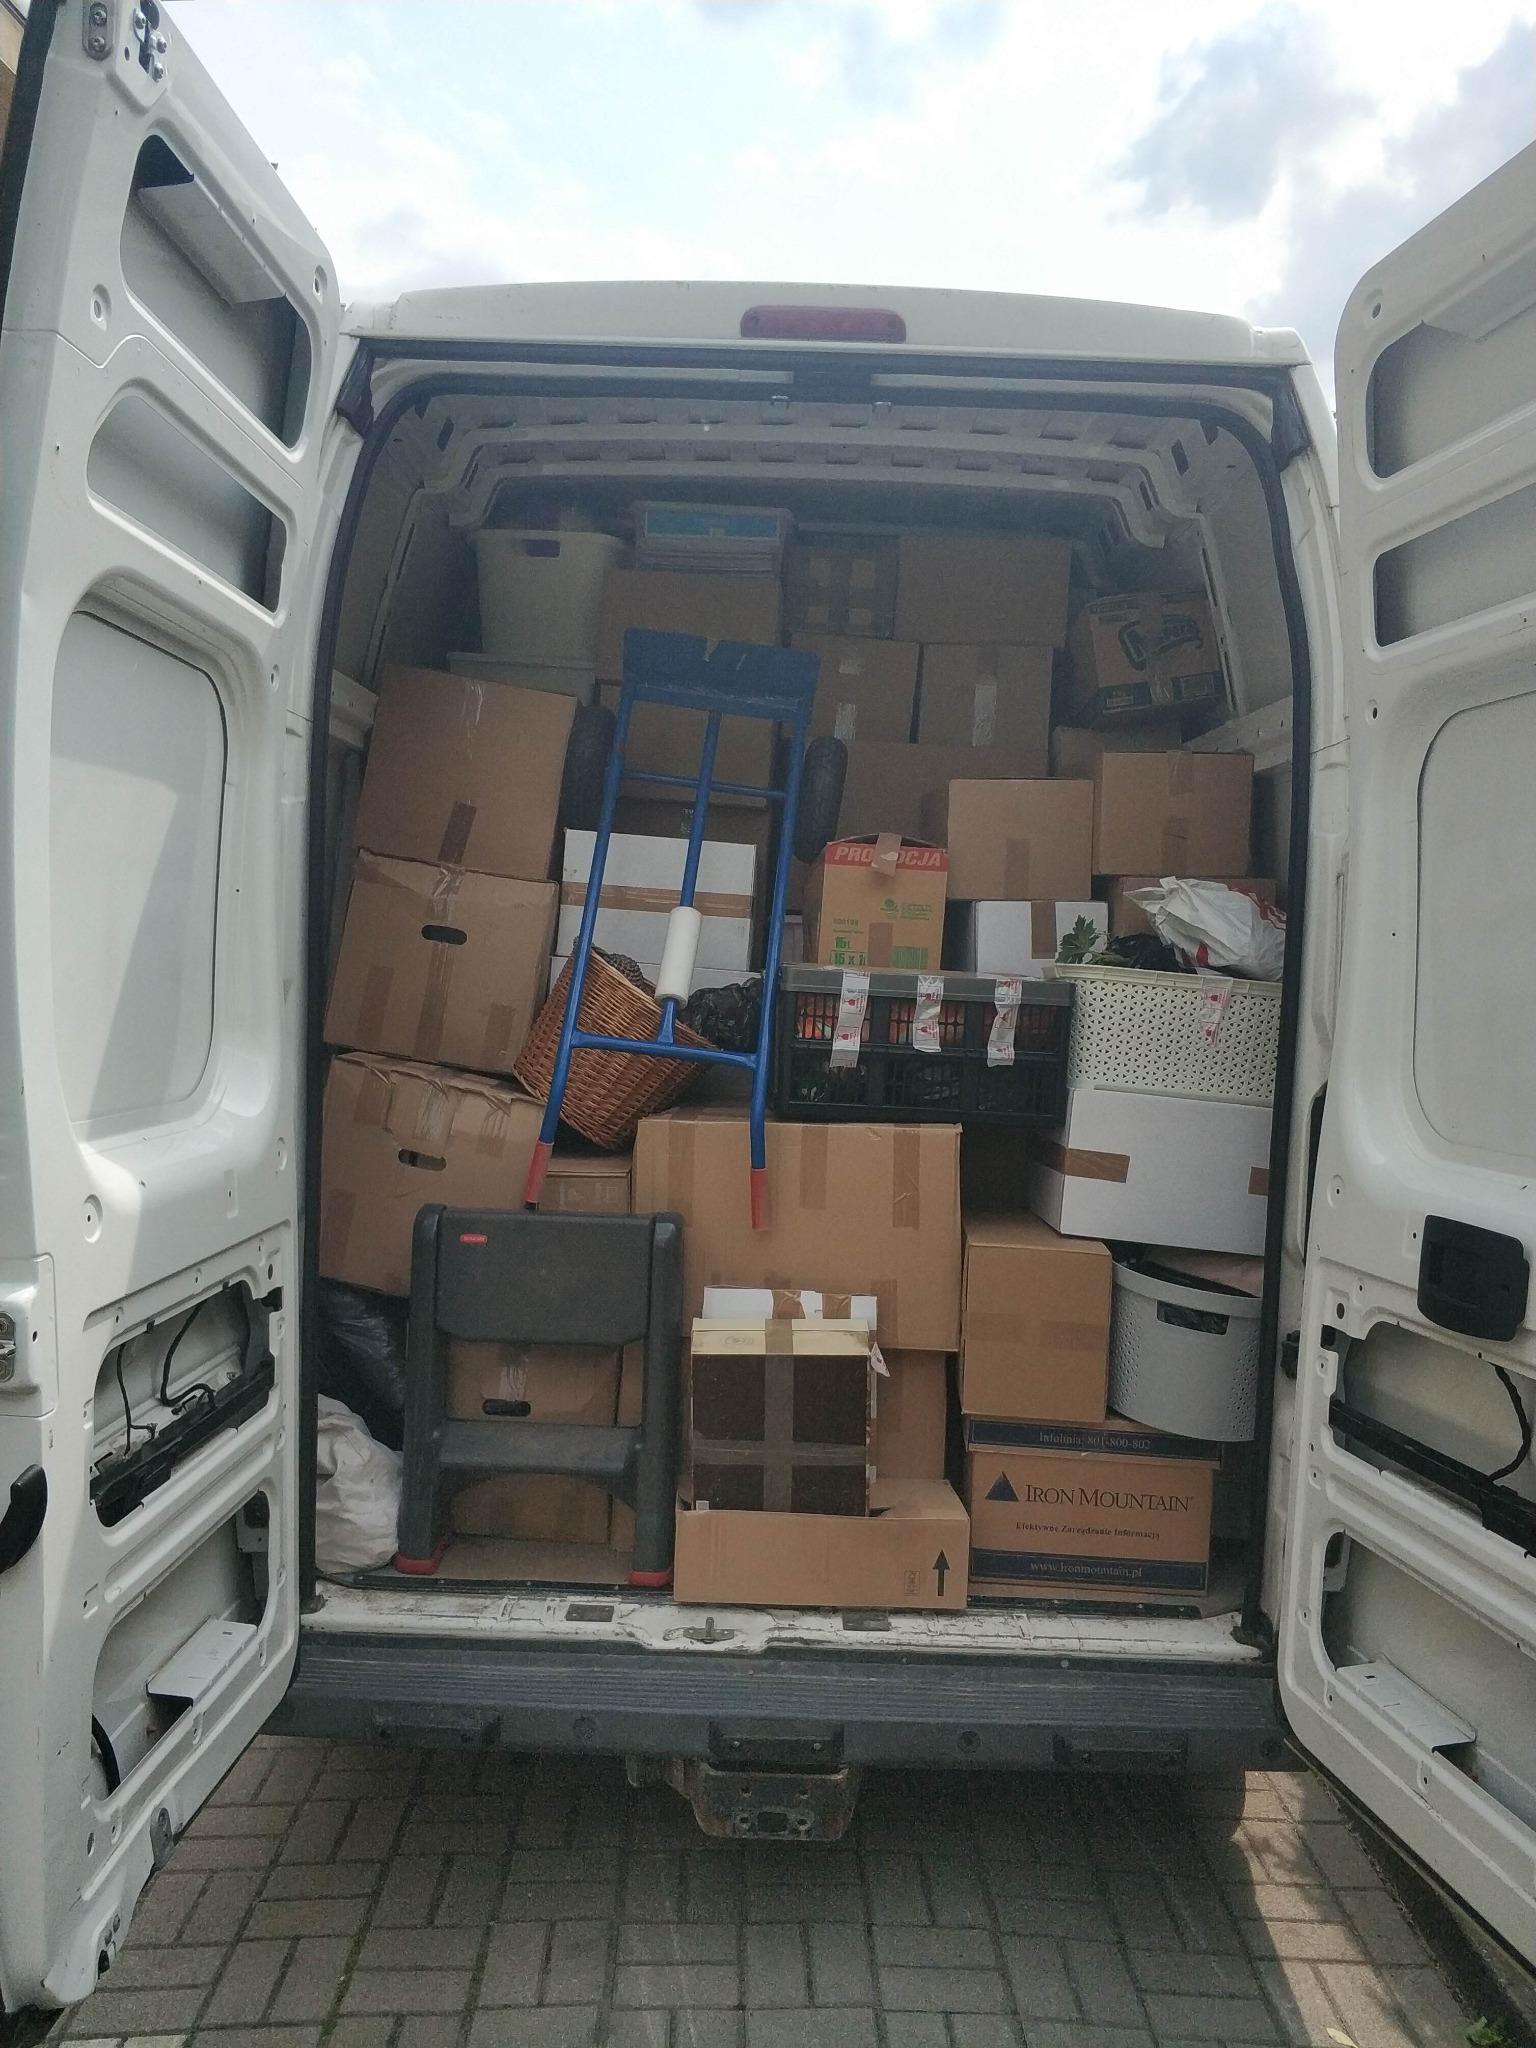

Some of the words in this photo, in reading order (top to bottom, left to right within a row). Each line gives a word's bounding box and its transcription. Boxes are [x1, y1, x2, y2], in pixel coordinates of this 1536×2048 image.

[834, 846, 942, 867] PROOCJA
[1025, 1484, 1075, 1506] IRON
[1078, 1487, 1190, 1512] MOUNTAIN
[1030, 1562, 1142, 1578] www.ironmountain.pl
